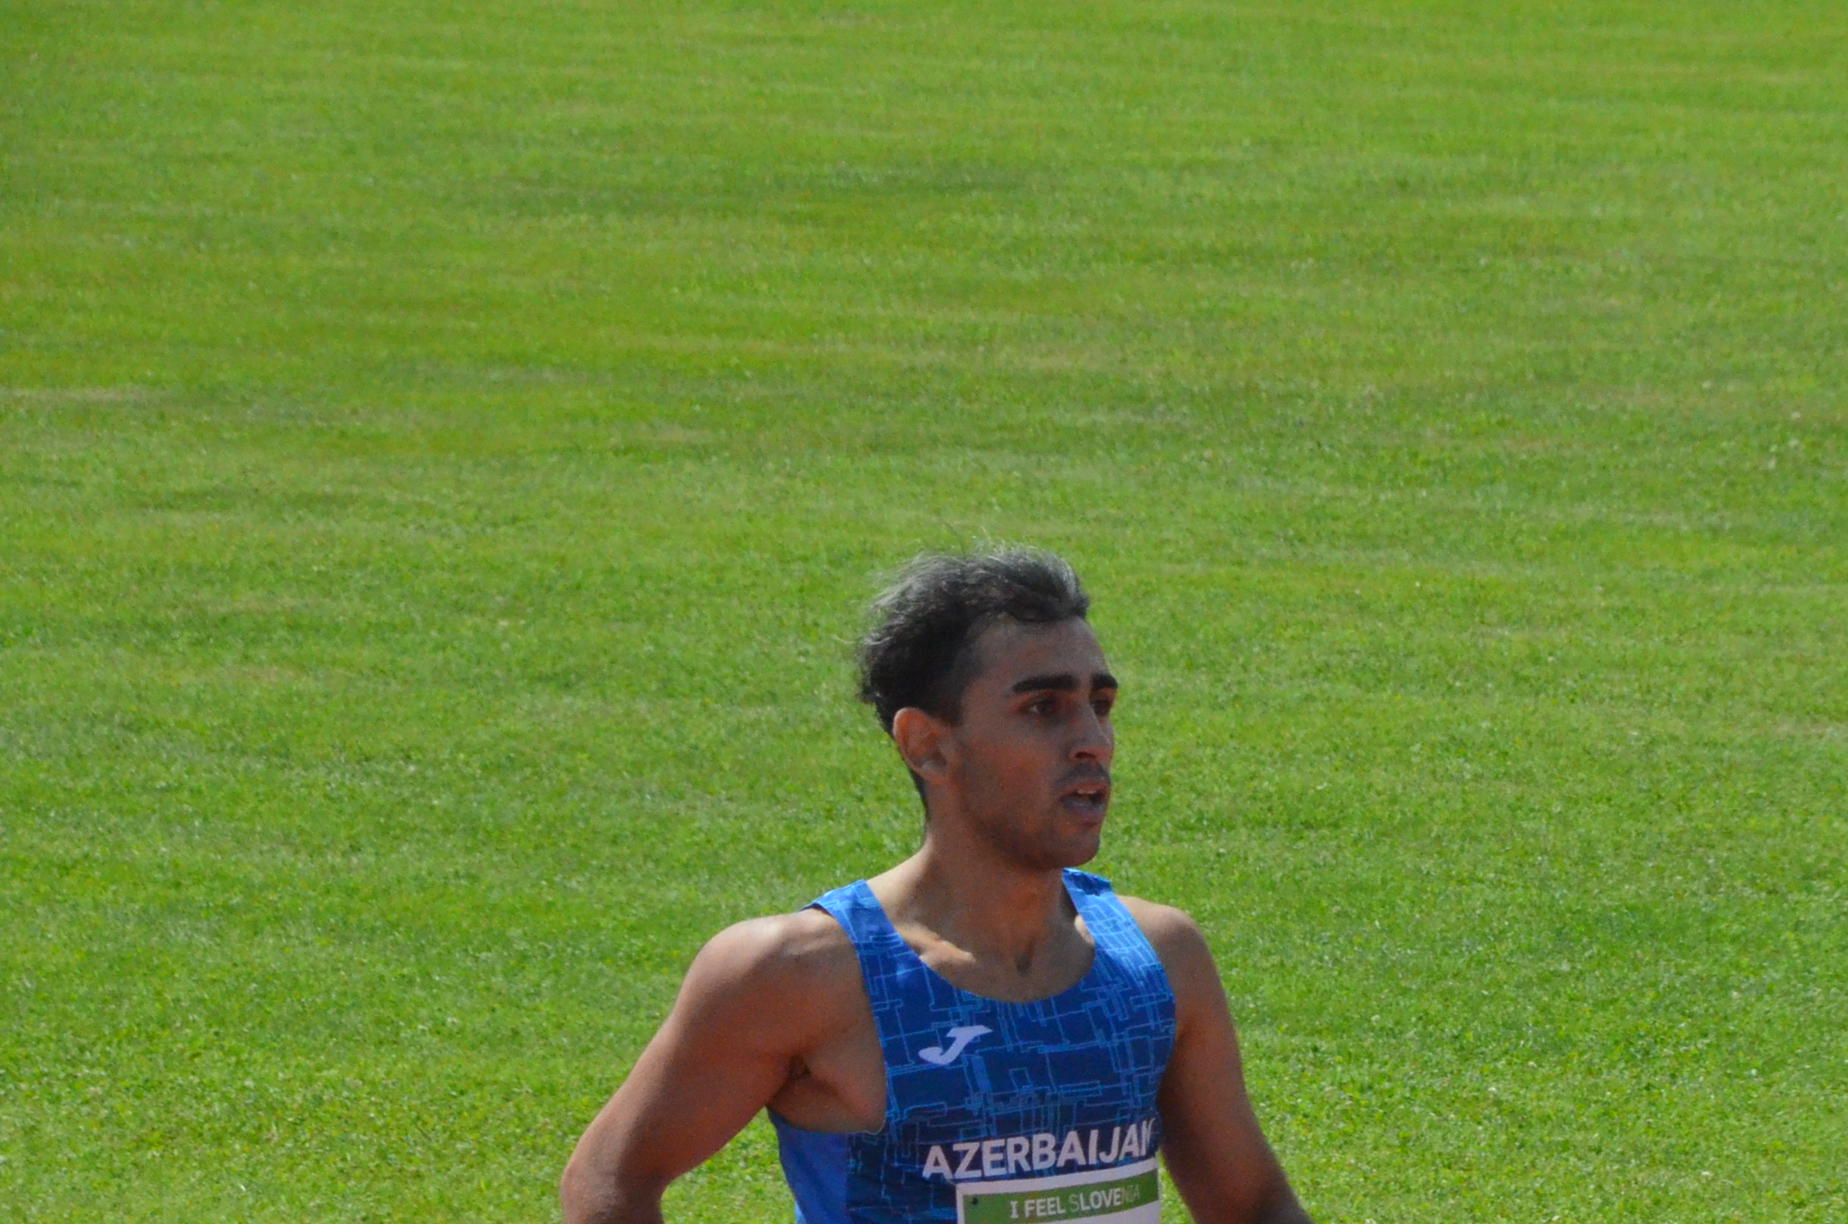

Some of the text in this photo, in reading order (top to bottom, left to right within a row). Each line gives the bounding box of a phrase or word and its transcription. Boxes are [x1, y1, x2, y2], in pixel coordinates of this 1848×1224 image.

[1010, 1185, 1140, 1218] I FEEL SLOVENIA
